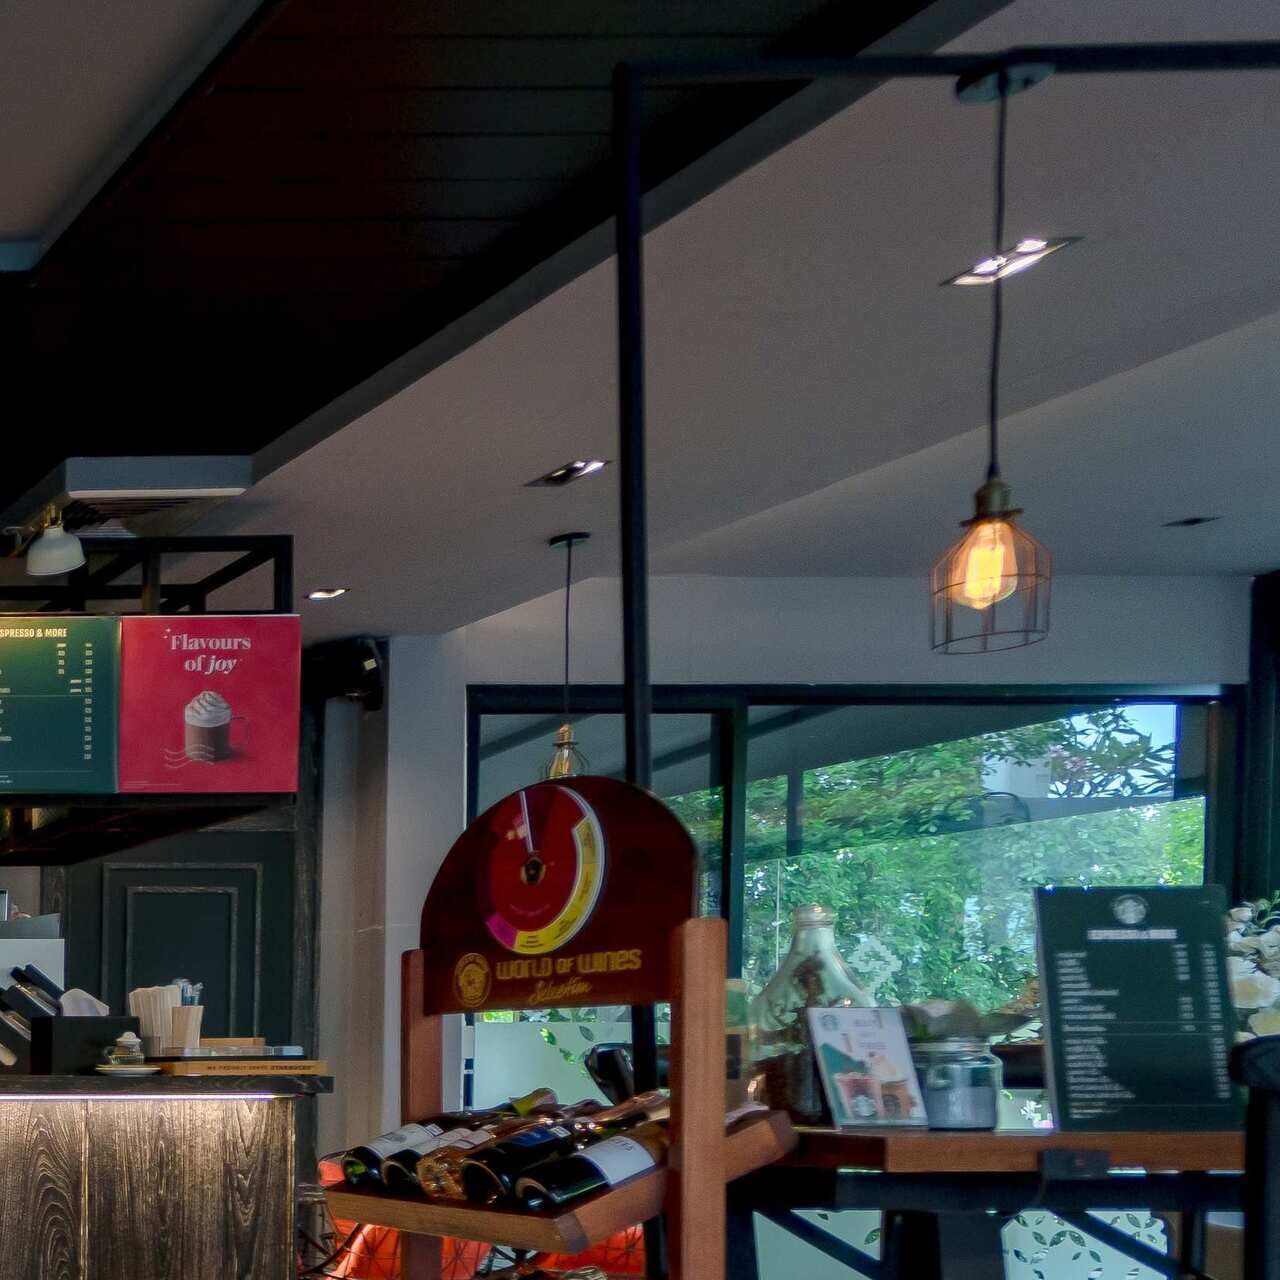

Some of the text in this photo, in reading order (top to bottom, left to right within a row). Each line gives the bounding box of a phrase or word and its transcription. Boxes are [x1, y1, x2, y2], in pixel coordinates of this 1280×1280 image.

[44, 628, 68, 638] MORE
[171, 633, 252, 651] Flavours
[184, 654, 238, 675] of joy
